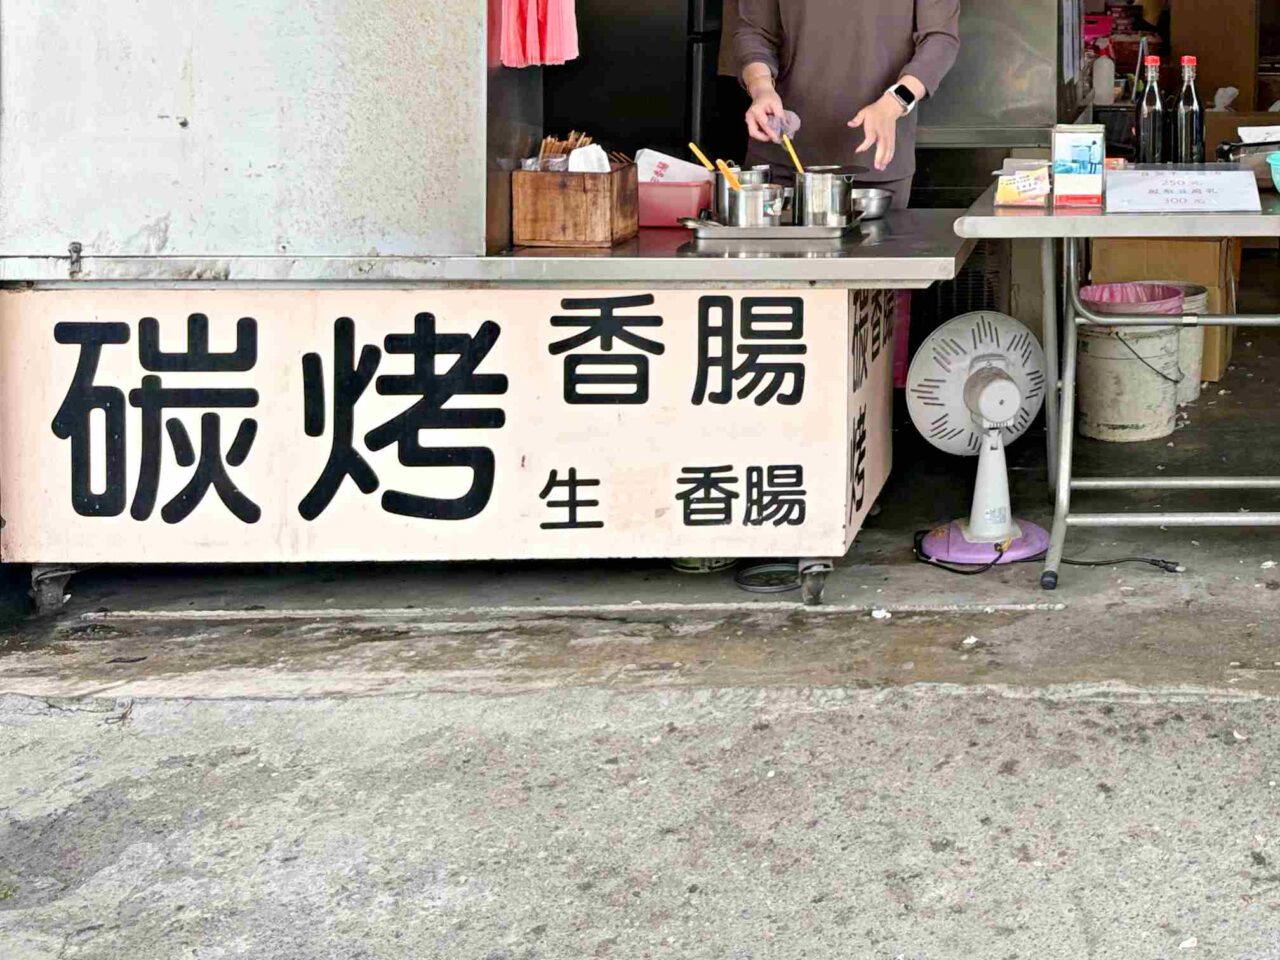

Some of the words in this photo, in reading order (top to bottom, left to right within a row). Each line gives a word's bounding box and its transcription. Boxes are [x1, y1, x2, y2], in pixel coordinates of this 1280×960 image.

[548, 293, 806, 406] 香腸
[53, 312, 510, 525] 碳烤
[539, 467, 604, 530] 生
[675, 464, 807, 527] 香腸
